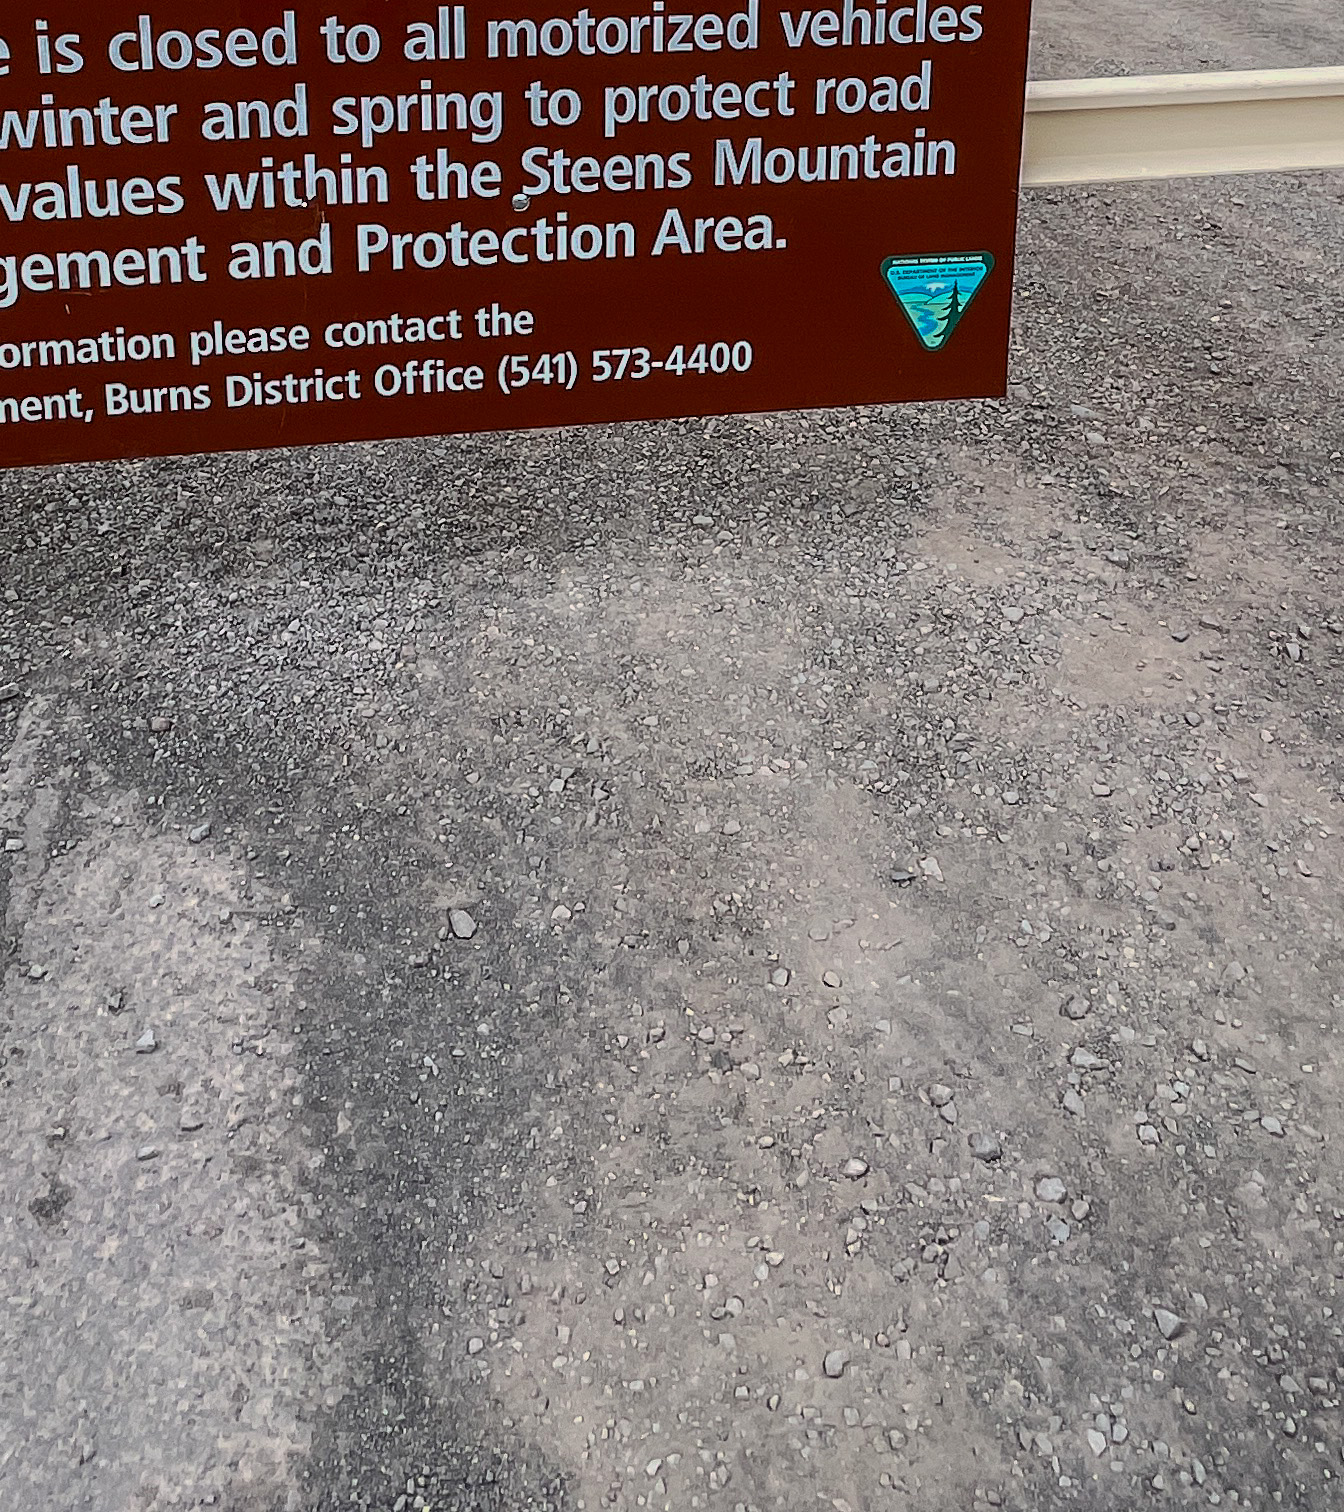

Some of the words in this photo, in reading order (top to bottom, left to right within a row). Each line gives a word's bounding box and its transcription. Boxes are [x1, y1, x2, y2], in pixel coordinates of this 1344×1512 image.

[35, 19, 84, 74] is
[108, 10, 297, 71] closed
[319, 15, 381, 64] to
[403, 5, 466, 61] all
[201, 82, 309, 141] and
[332, 79, 503, 148] spring
[524, 80, 582, 127] to
[604, 71, 796, 138] protect
[815, 59, 932, 115] road
[203, 152, 389, 211] within
[409, 147, 502, 201] the
[521, 146, 692, 196] Steens
[714, 127, 956, 186] Mountain
[228, 222, 333, 280] and
[357, 211, 635, 272] Protection
[650, 207, 787, 256] Area.
[189, 320, 310, 366] please
[324, 309, 463, 348] contact
[474, 302, 534, 338] the
[105, 382, 212, 416] Burns
[225, 368, 362, 408] District
[374, 359, 484, 397] Office
[498, 351, 578, 395] (541)
[592, 340, 753, 382] 573-4400
